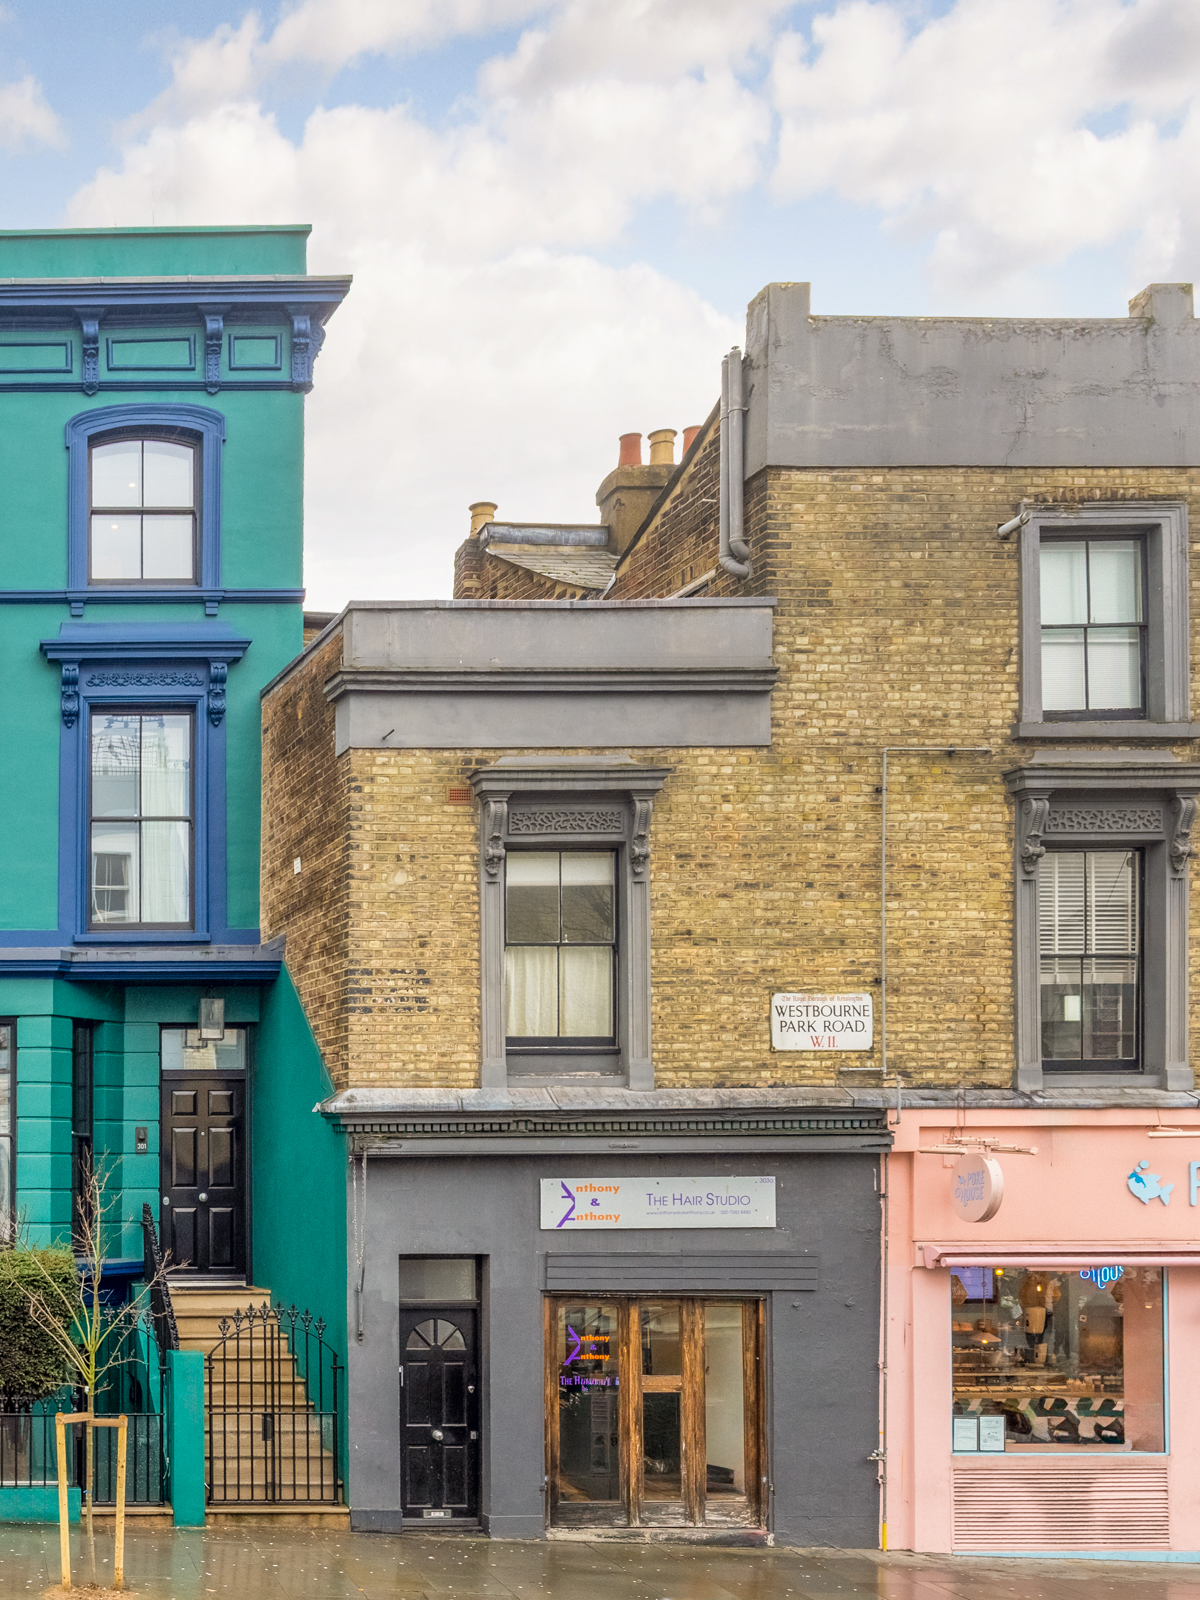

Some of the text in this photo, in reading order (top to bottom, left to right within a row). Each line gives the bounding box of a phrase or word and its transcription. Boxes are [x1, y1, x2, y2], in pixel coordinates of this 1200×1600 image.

[775, 1005, 870, 1017] WESTBOURNE
[780, 1020, 867, 1032] PARK ROAD.
[590, 1198, 600, 1206] &
[646, 1192, 751, 1206] THE HAIR STUDIO
